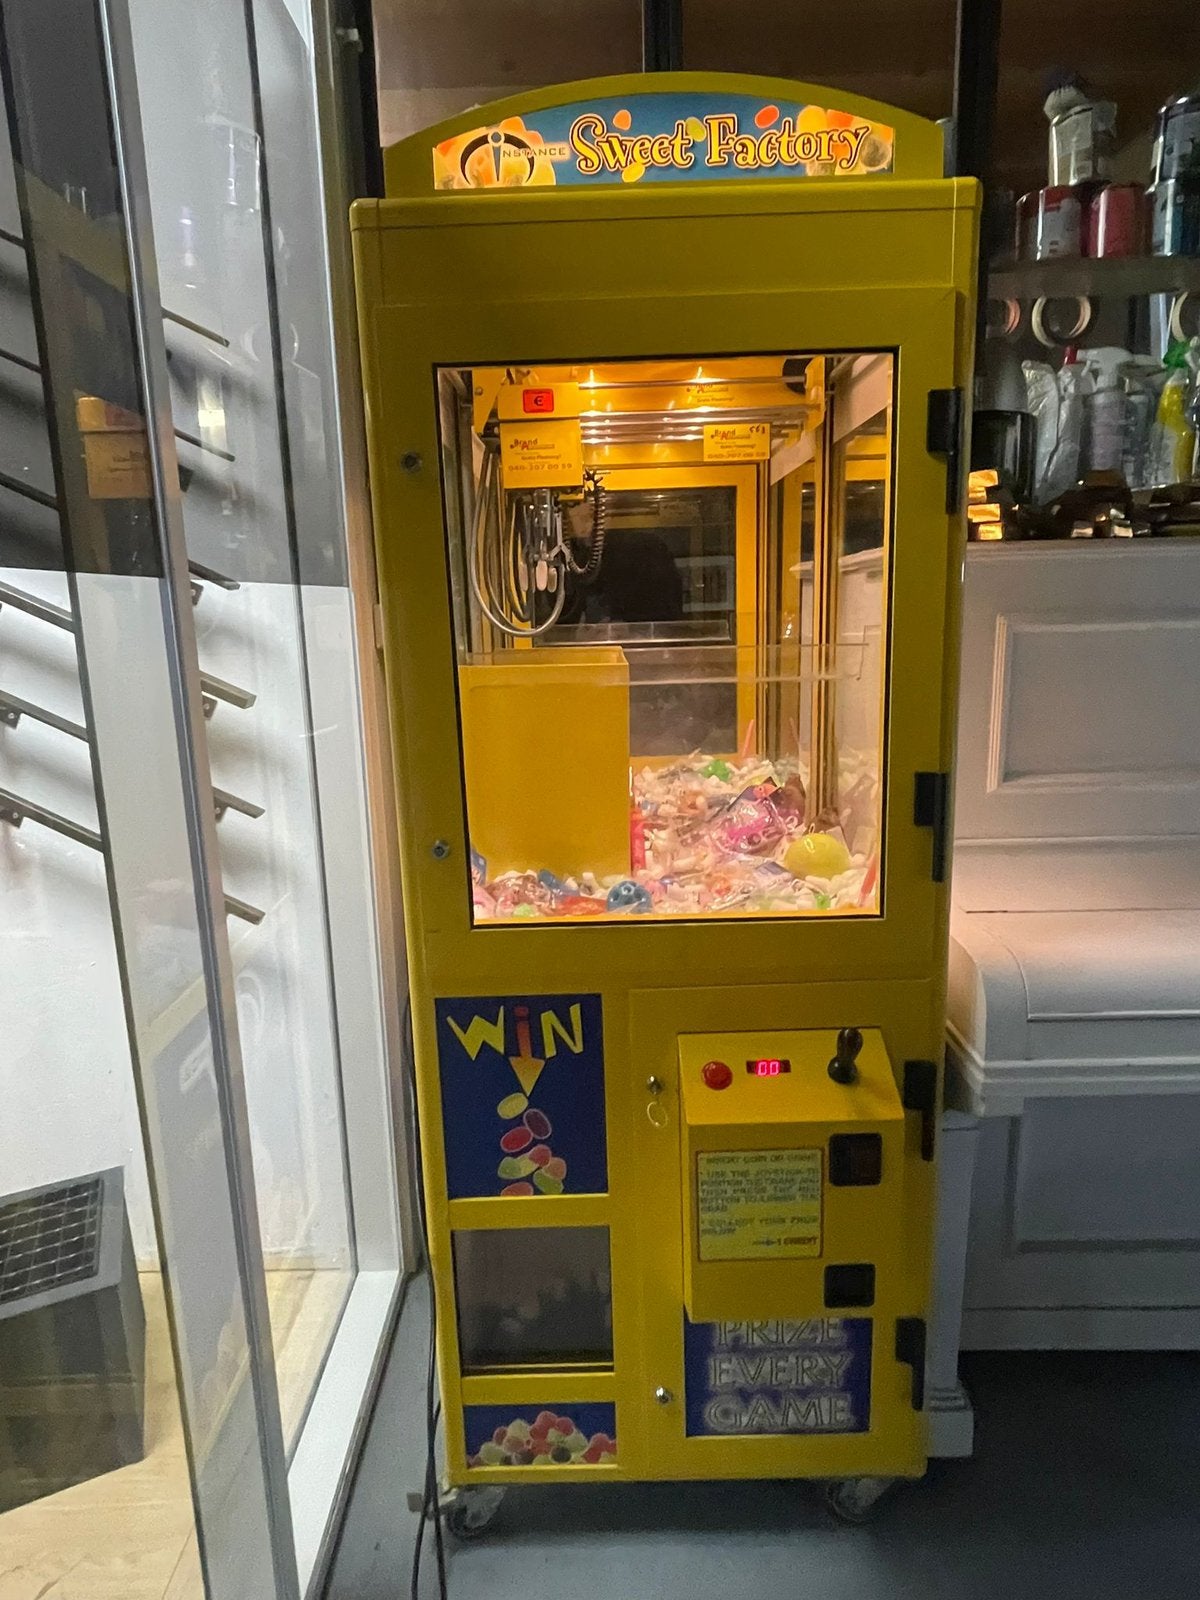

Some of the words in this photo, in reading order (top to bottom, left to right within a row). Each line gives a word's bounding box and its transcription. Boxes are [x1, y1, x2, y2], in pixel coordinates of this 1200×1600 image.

[570, 115, 692, 172] Sweet
[704, 115, 870, 169] Factory
[718, 1318, 844, 1347] PRIZE
[711, 1353, 848, 1387] EVERY
[707, 1394, 852, 1429] GAME
